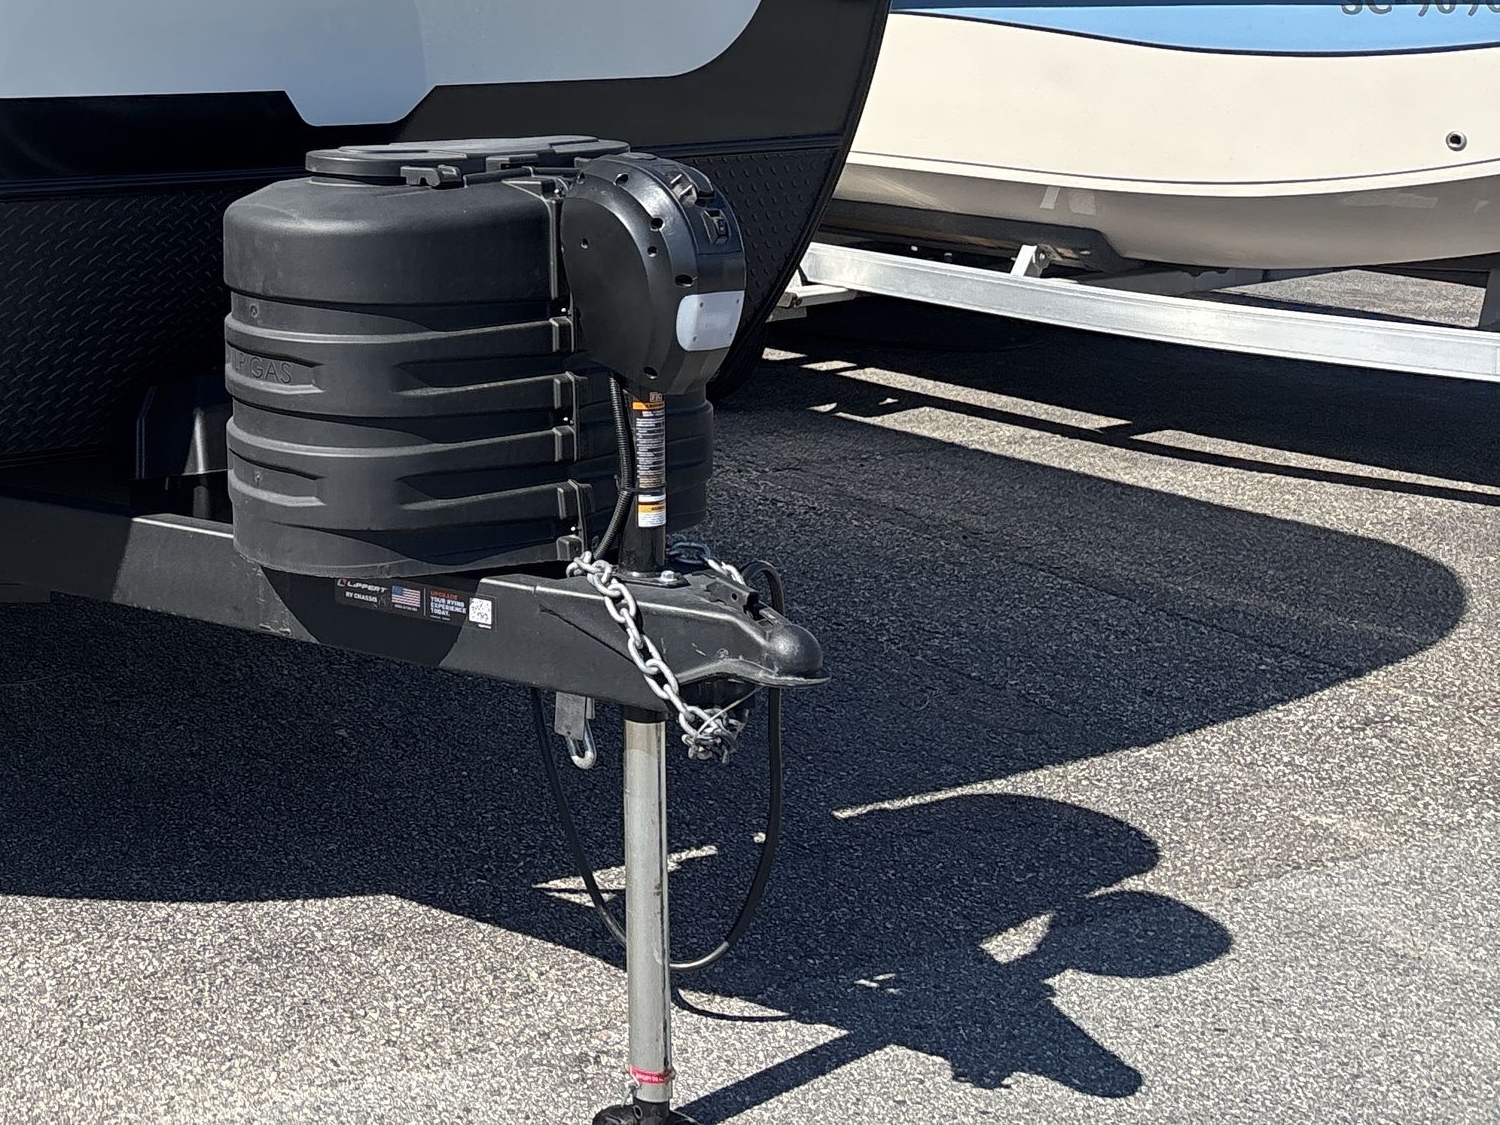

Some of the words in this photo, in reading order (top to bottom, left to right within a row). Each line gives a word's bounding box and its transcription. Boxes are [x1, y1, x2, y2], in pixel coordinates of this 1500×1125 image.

[250, 356, 293, 384] GAS
[354, 592, 378, 603] CHASSIS
[430, 596, 446, 604] YOUR
[430, 602, 467, 614] EXPERIENCE
